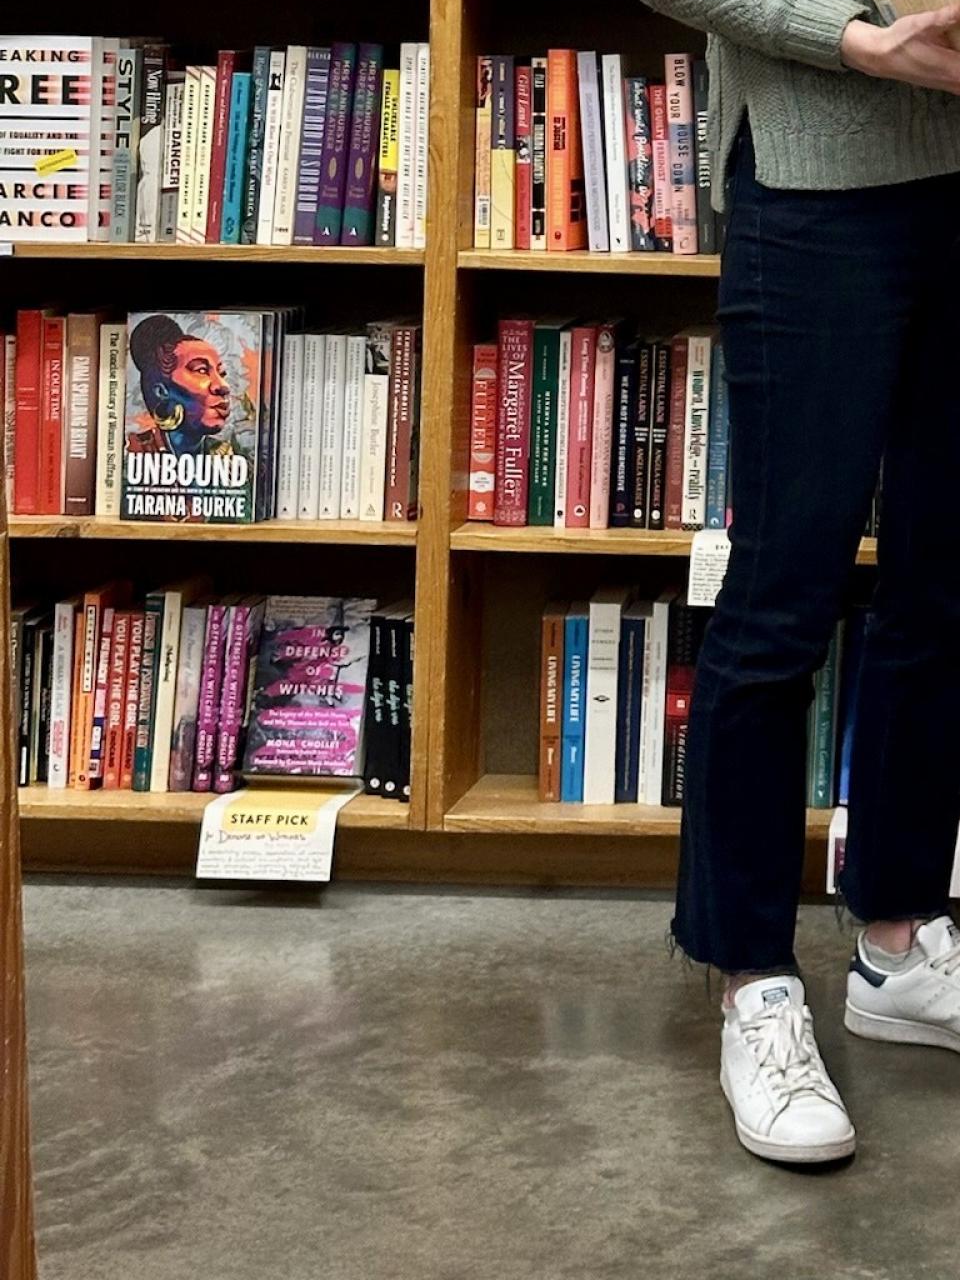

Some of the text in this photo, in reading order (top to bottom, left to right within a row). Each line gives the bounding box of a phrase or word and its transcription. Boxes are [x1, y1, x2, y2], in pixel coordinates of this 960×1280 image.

[116, 59, 133, 148] STYLE
[670, 58, 689, 193] BLOW YOUR HOUSE DOWN
[169, 130, 182, 186] DANGER
[474, 380, 488, 450] FULLER
[504, 361, 525, 497] Margaret Fuller
[127, 452, 248, 487] UNBOUND
[126, 494, 246, 517] TARANA BURKE
[109, 619, 126, 729] YOU PLAY THE GIRL
[285, 645, 347, 658] DEFENSE
[279, 683, 344, 697] WITCHES
[266, 739, 340, 749] MONA CHOLLET
[675, 725, 688, 800] Vindication
[231, 814, 309, 826] STAFF PICK
